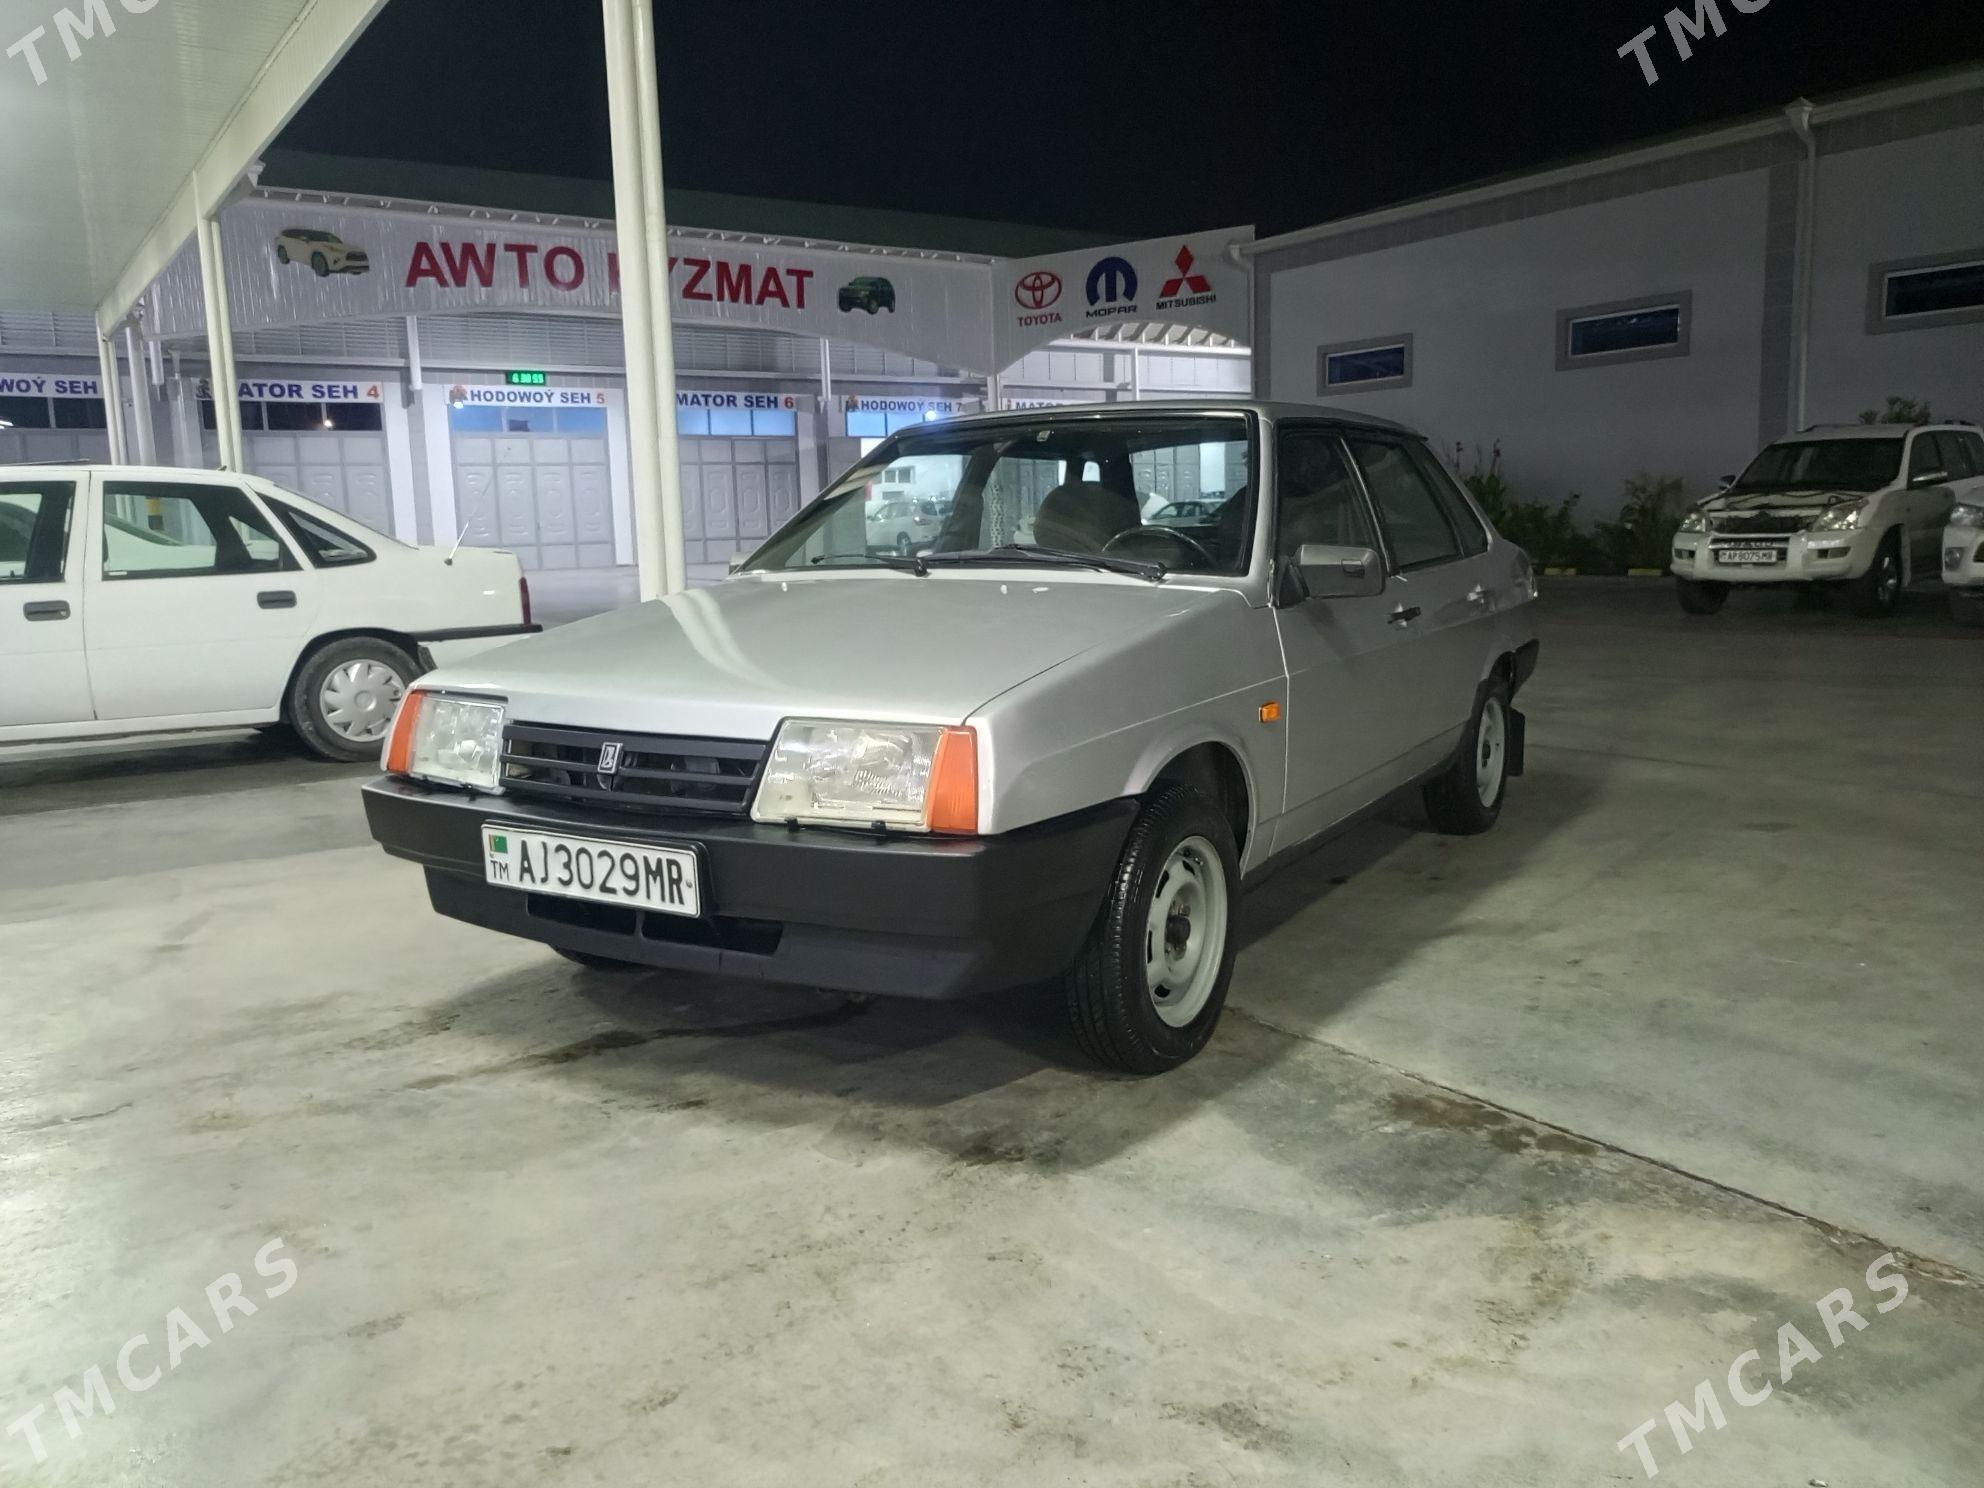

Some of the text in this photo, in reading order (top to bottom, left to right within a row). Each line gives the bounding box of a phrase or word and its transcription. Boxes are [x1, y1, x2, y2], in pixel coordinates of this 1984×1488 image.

[405, 241, 814, 310] AWTO ZMAT
[1156, 294, 1217, 311] MITSUBISHI
[1086, 305, 1138, 319] MOPAR
[1017, 312, 1063, 328] TOYOTA
[54, 380, 98, 395] SEH
[238, 382, 380, 400] ATOR SEH 4
[560, 391, 592, 404] SEH
[596, 393, 606, 404] 5
[744, 395, 779, 409] SEH
[784, 396, 795, 409] 6
[927, 401, 952, 413] SEH
[956, 402, 963, 412] 7
[490, 839, 685, 906] TM AJ3029MR
